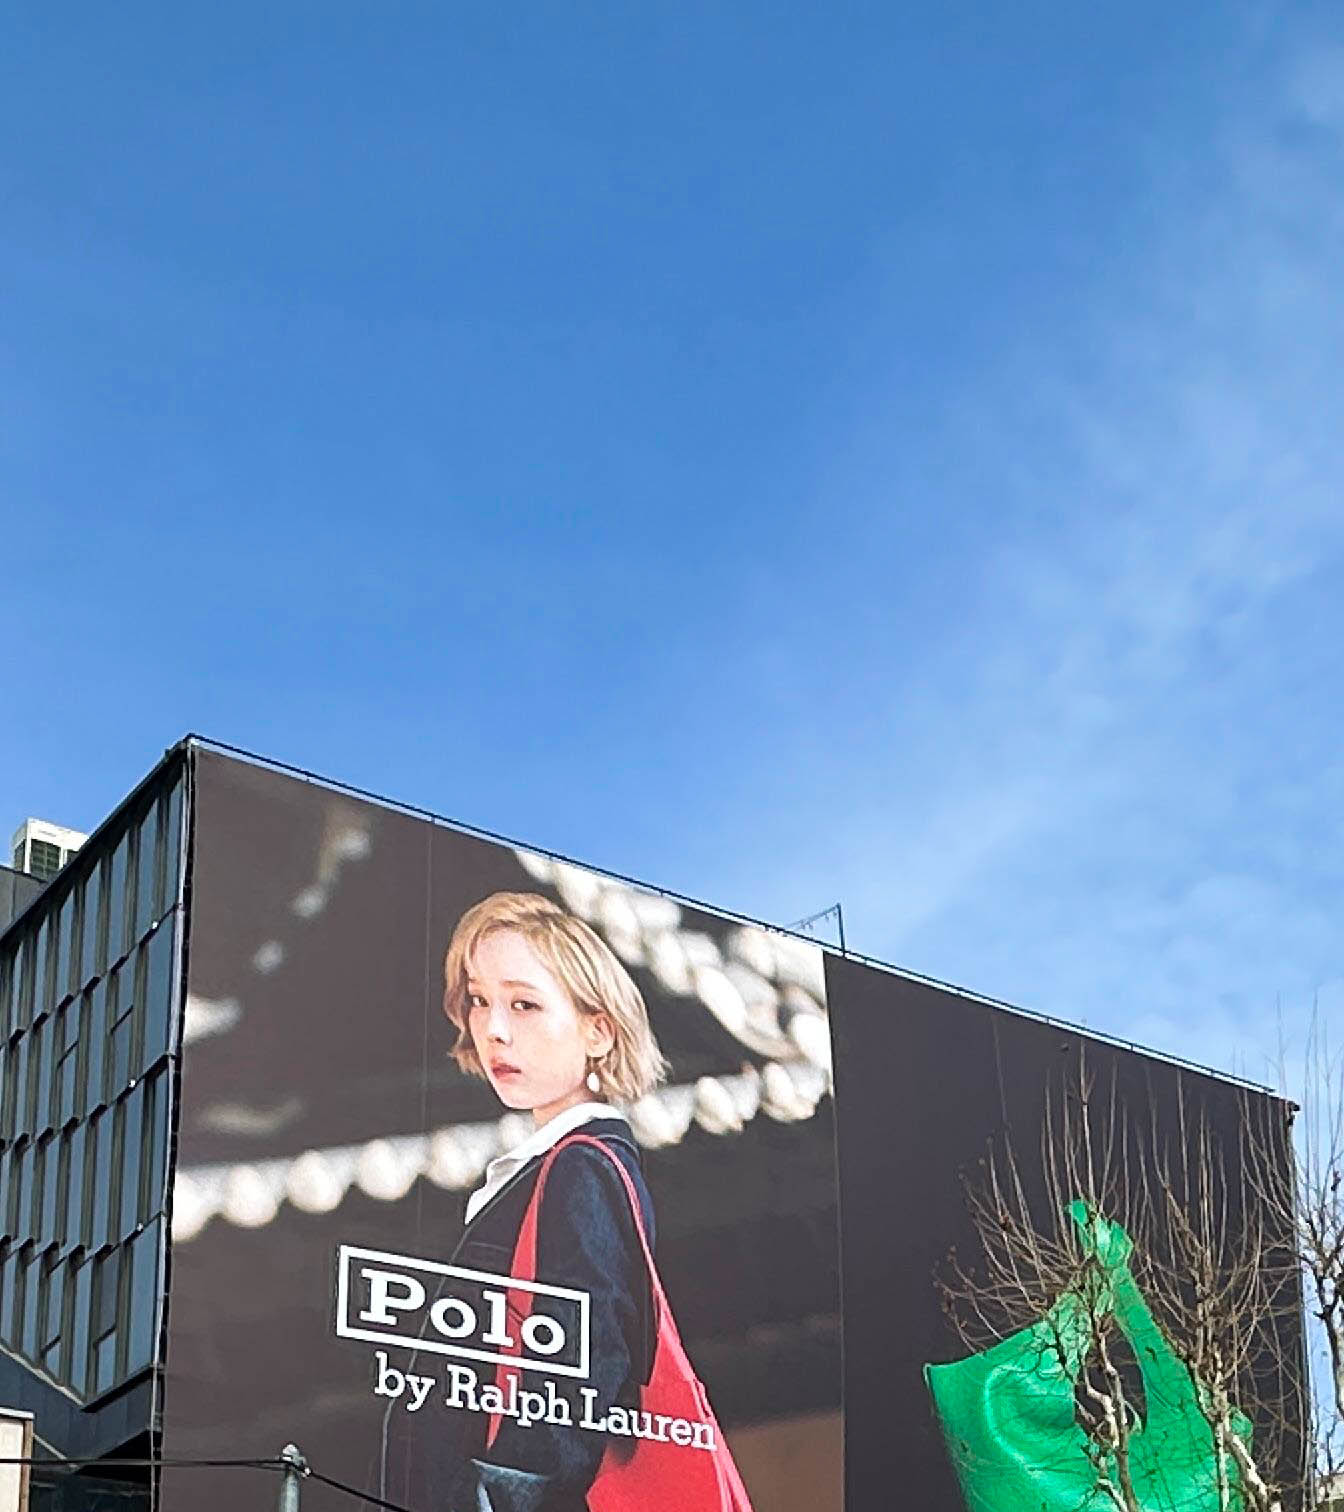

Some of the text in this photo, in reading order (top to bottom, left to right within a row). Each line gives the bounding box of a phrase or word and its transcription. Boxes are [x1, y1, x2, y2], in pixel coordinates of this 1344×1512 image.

[359, 1268, 567, 1355] Polo
[374, 1351, 717, 1451] by Ralph Lauren
